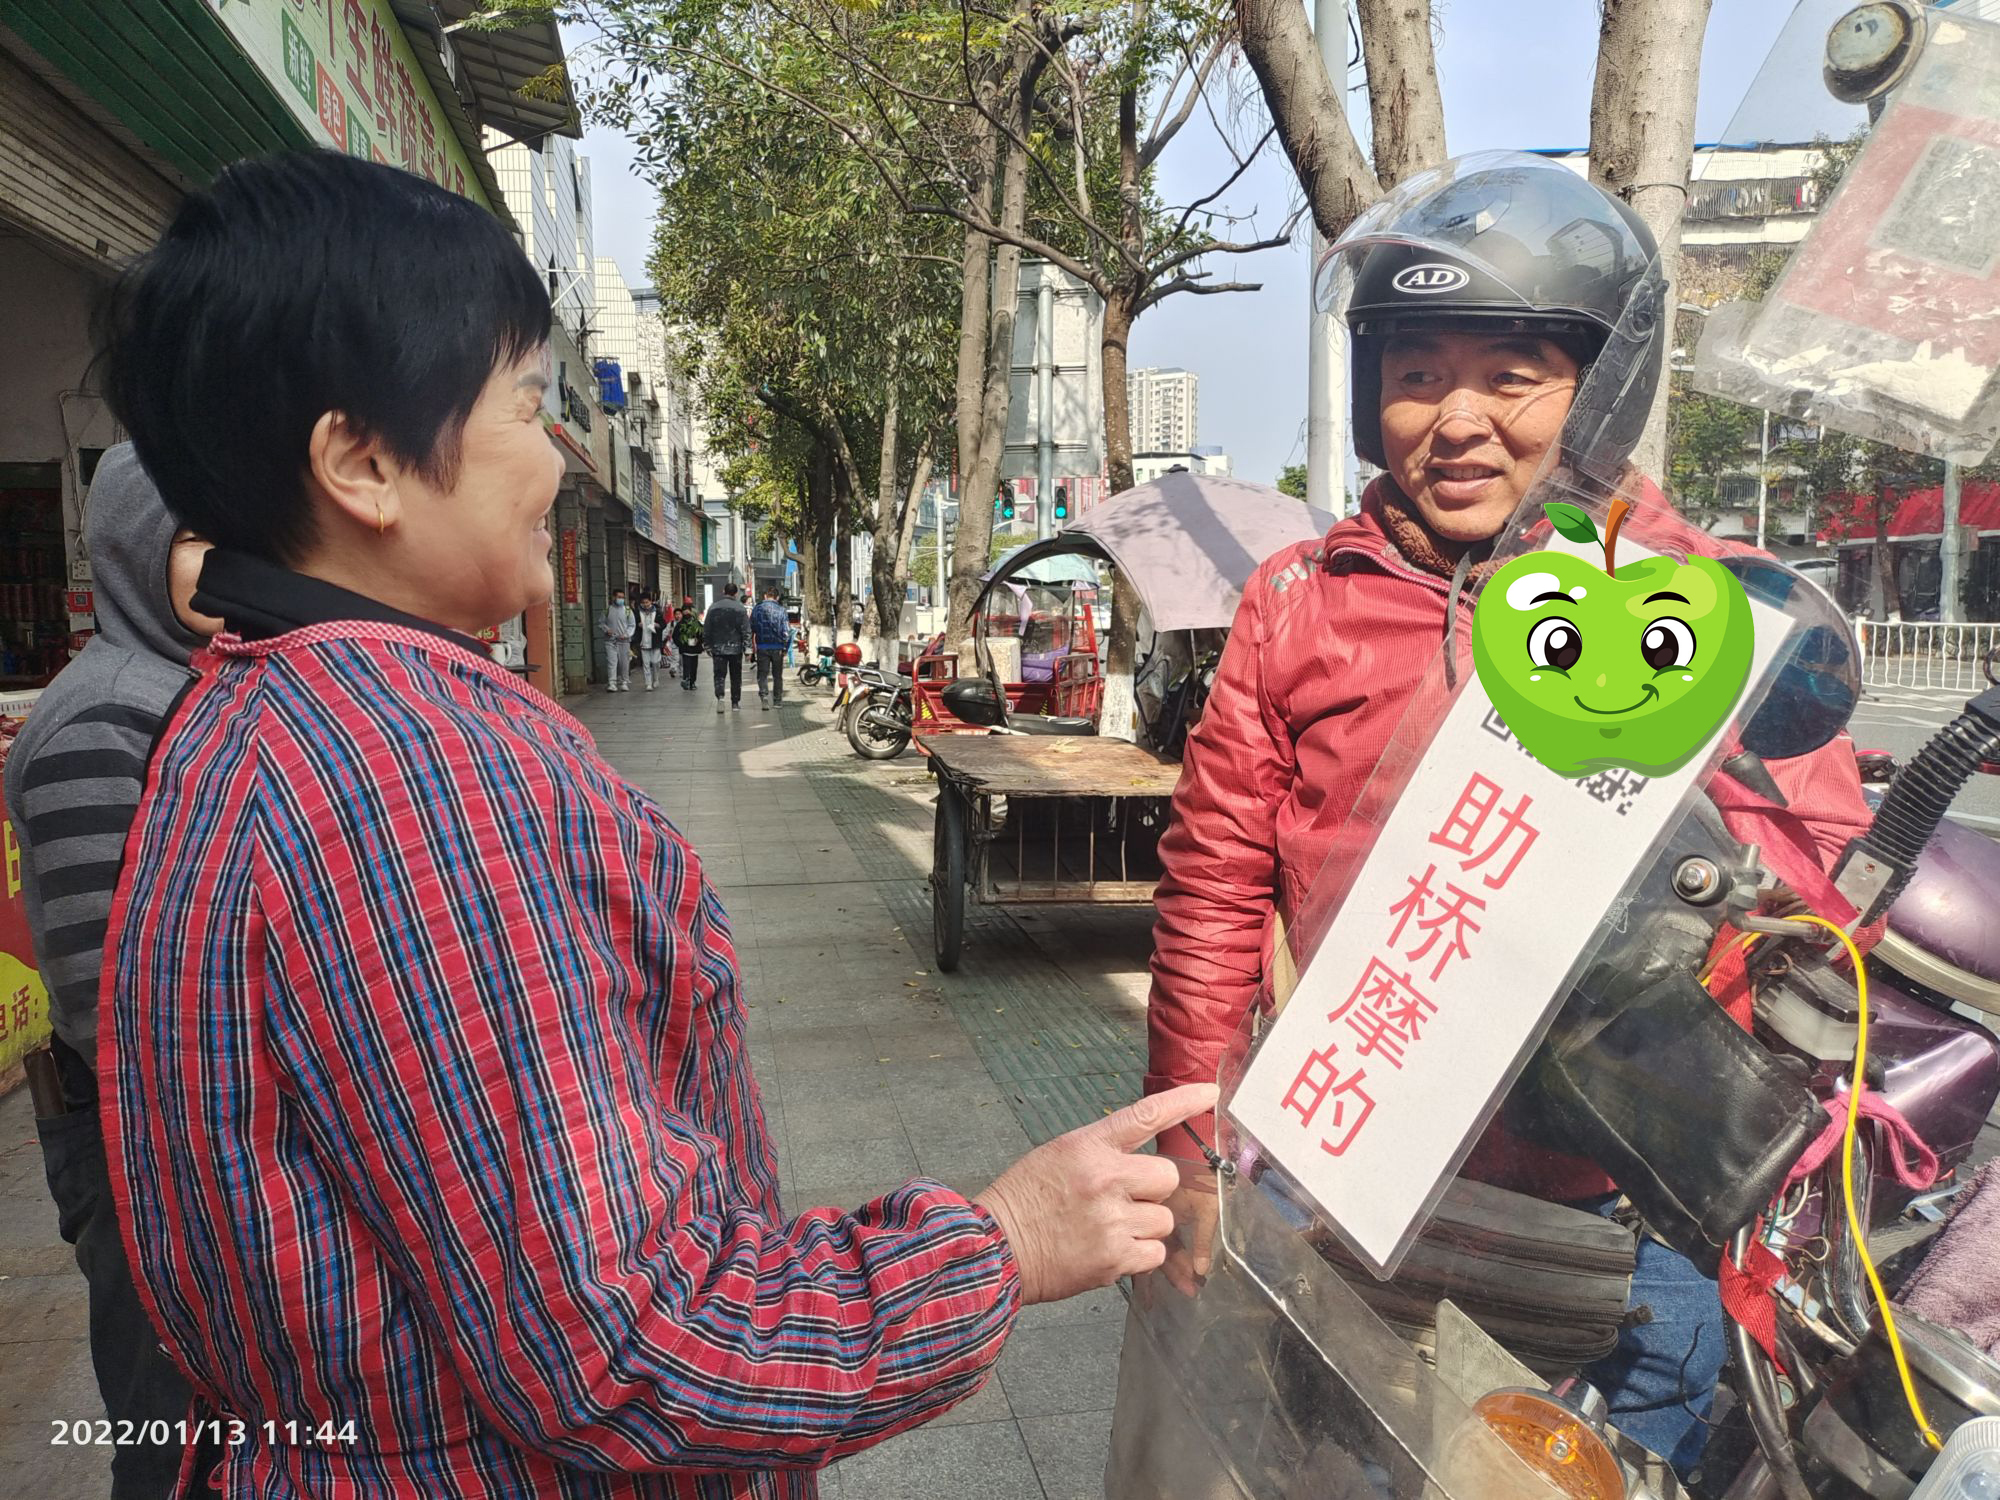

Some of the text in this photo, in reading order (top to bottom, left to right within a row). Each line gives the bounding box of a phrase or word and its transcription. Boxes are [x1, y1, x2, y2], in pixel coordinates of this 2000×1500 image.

[288, 25, 311, 100] 新鲜
[321, 75, 342, 142] 绿色
[1403, 270, 1455, 286] AD
[1279, 770, 1541, 1158] 助桥摩的
